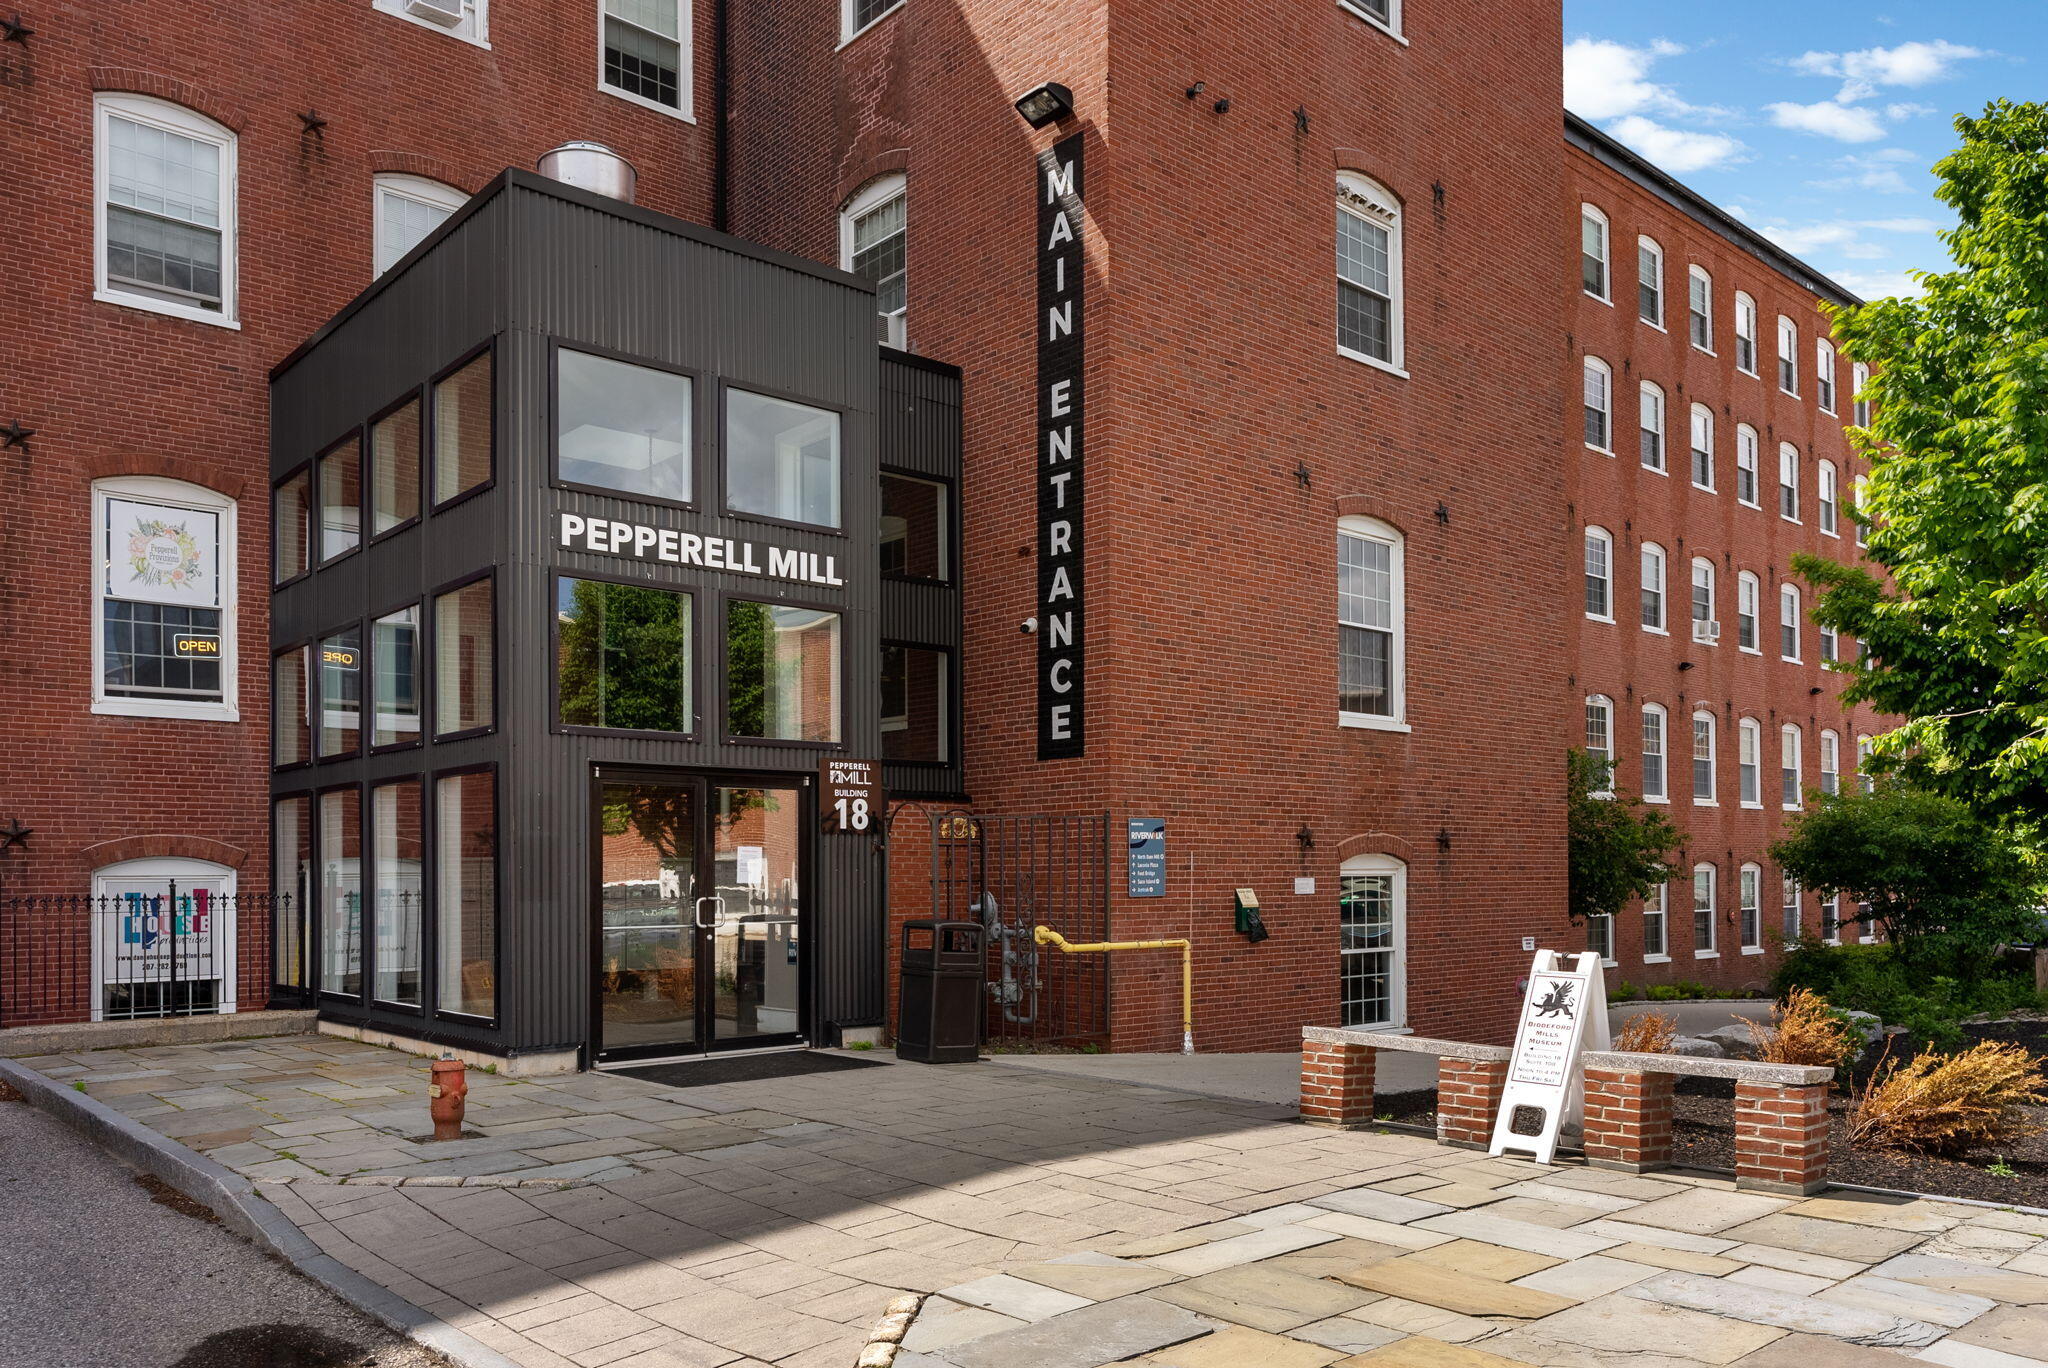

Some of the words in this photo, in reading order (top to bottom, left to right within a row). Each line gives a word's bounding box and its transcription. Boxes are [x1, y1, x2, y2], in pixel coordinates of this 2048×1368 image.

[1048, 160, 1074, 342] MAIN
[561, 513, 762, 574] PEPPERELL
[768, 546, 843, 586] MILL
[1048, 380, 1074, 740] ENTRANCE
[179, 640, 217, 652] OPEN
[829, 761, 871, 771] PEPPERELL
[841, 770, 872, 785] MILL
[834, 789, 869, 798] BUILDING
[834, 798, 869, 830] 18
[1527, 1021, 1572, 1031] BIDDEFORD
[1528, 1038, 1563, 1046] MUSEUM
